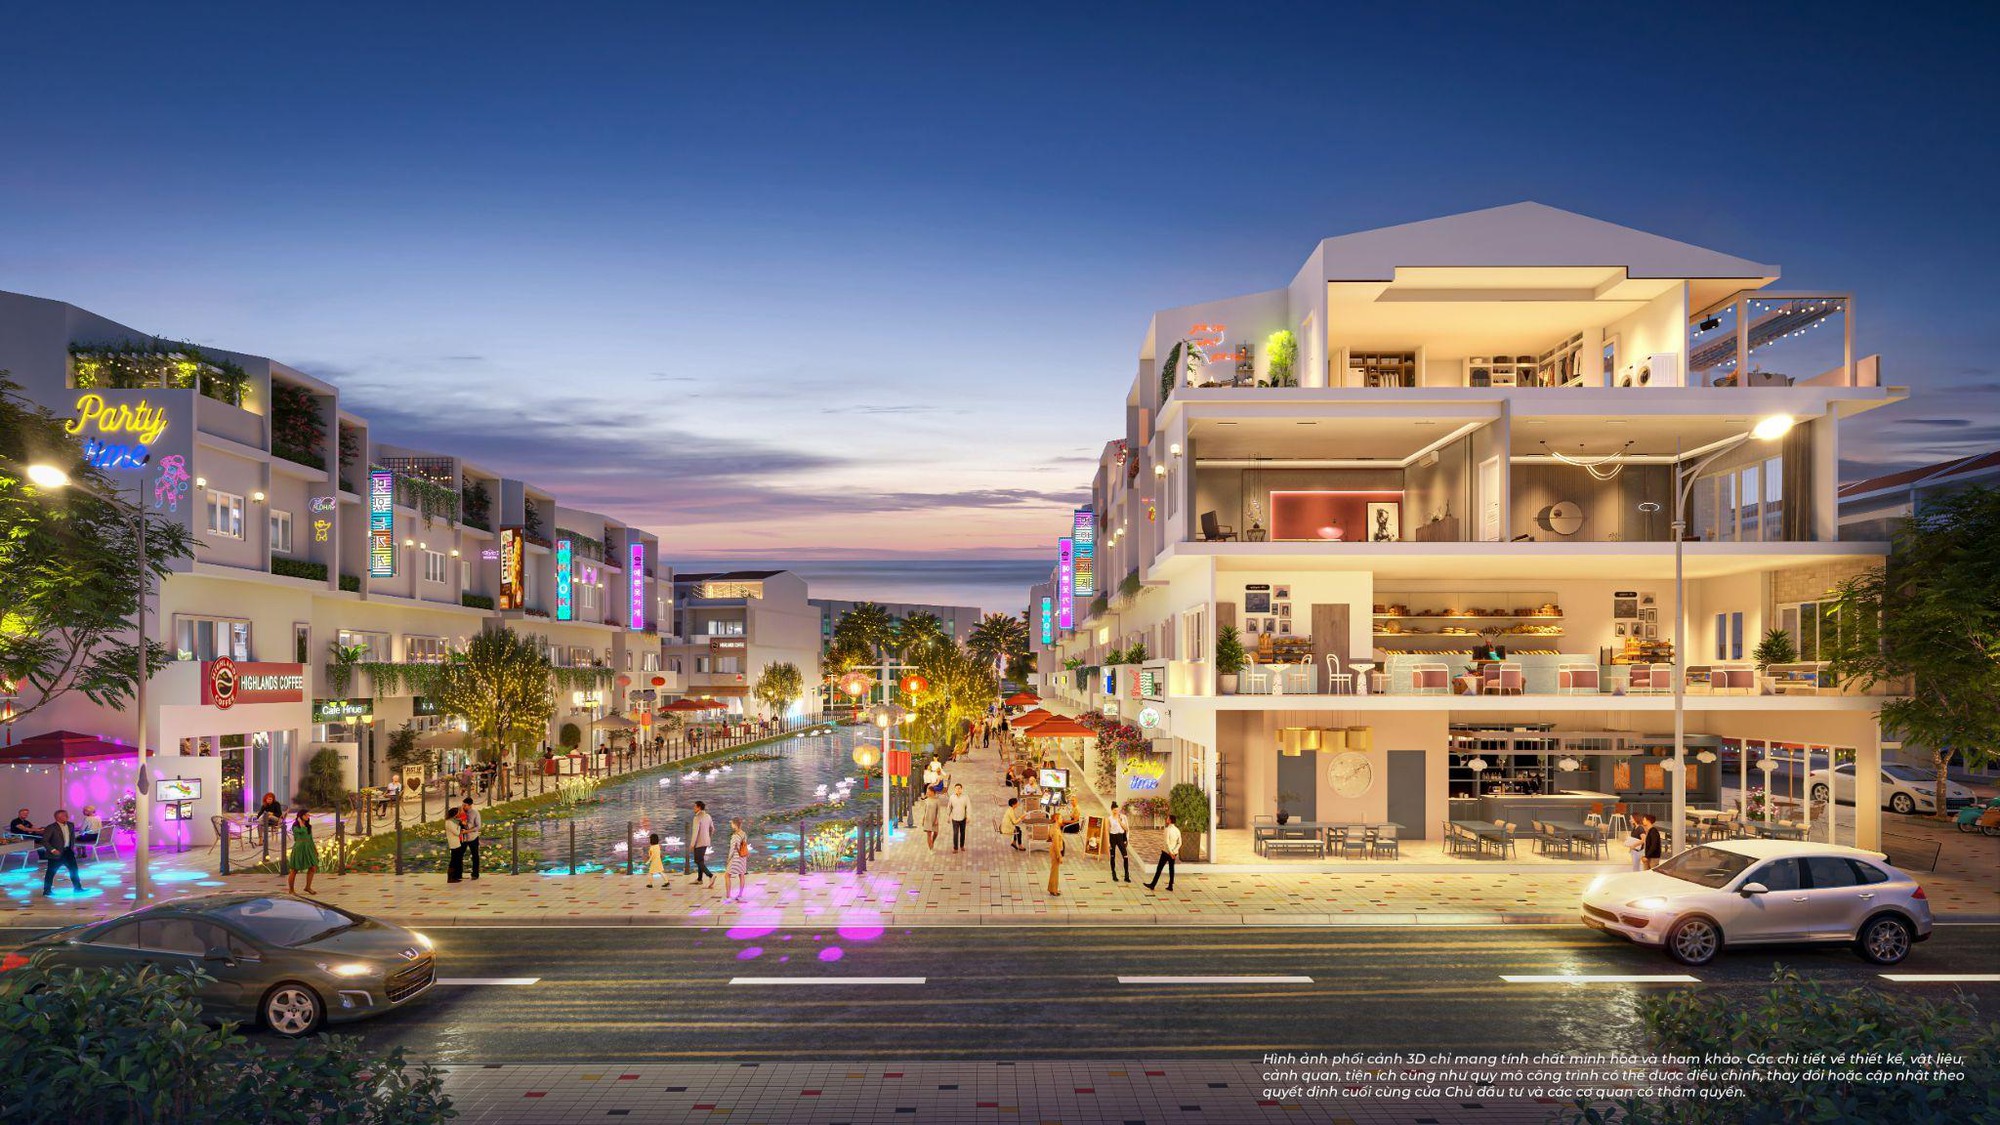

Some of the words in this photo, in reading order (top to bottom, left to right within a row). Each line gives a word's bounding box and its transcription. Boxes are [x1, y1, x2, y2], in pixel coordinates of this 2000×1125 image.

[65, 394, 168, 445] Party
[83, 437, 150, 469] time
[240, 675, 278, 690] HIGHLANDS
[279, 675, 303, 690] COFFEE
[321, 705, 341, 715] Cafe
[1121, 757, 1166, 780] Party
